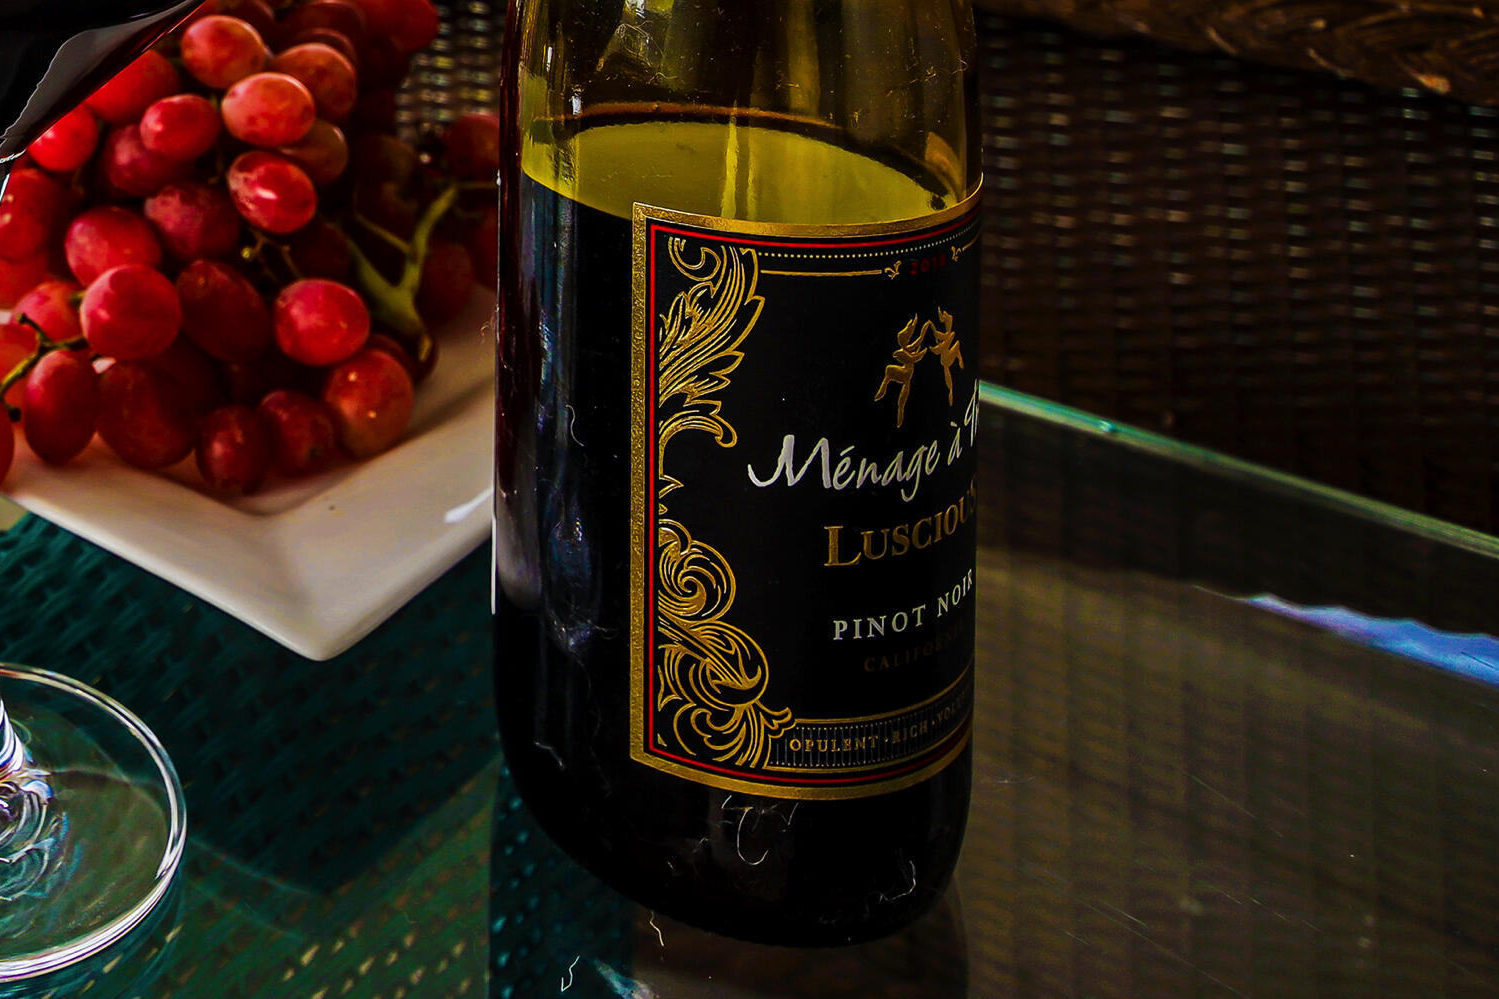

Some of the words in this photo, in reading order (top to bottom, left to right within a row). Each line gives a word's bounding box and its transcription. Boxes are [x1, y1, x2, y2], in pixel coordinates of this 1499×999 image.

[747, 434, 941, 503] Ménage
[947, 420, 963, 467] à
[832, 603, 927, 642] PINOT
[936, 568, 973, 619] NOIR
[788, 735, 880, 754] OPULENT
[892, 718, 929, 745] RICH
